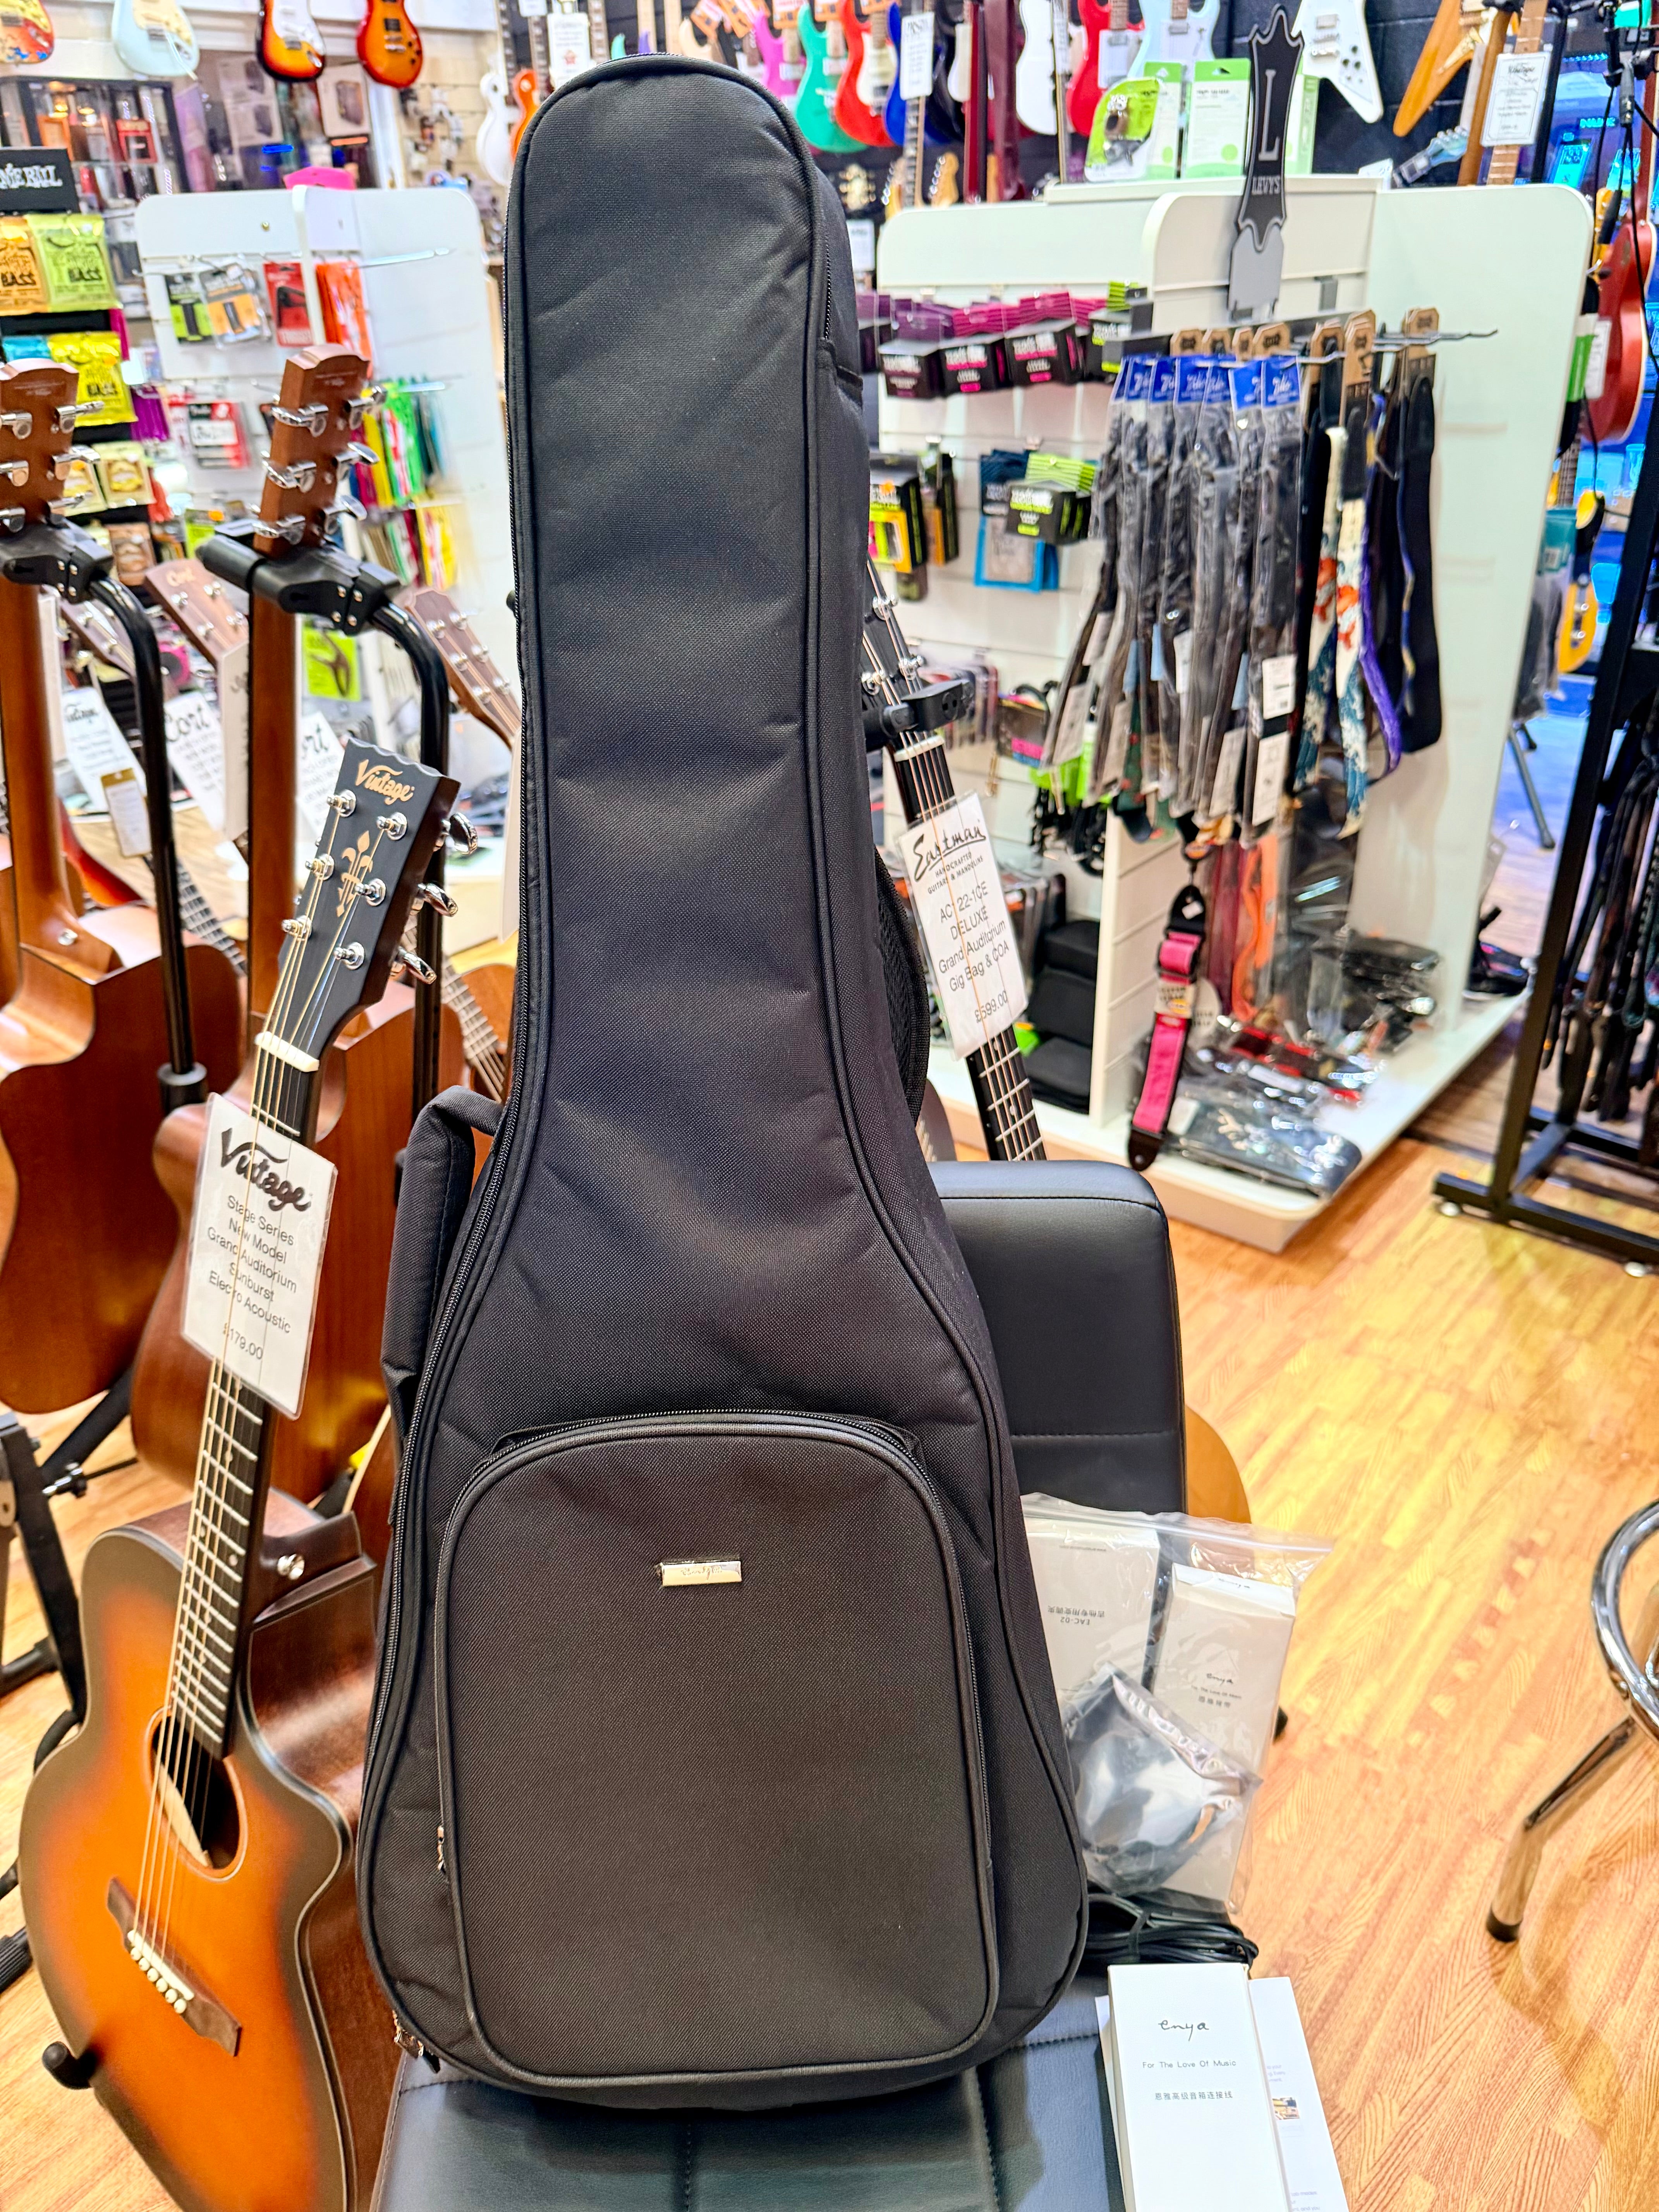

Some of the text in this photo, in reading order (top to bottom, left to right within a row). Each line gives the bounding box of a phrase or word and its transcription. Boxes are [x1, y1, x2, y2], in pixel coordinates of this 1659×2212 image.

[355, 759, 415, 805] Vintage
[913, 826, 986, 882] Eastman
[935, 852, 972, 878] HANDCRAFTED
[950, 905, 988, 940] DELUXE
[939, 920, 1006, 974] Grand Auditorium
[950, 940, 1010, 991] Gig Bag & COA
[974, 990, 1008, 1023] £599.00
[221, 1127, 311, 1212] Vintage
[227, 1195, 294, 1246] Stage Series
[252, 1234, 287, 1264] Model
[229, 1262, 274, 1302] Sunburst
[241, 1249, 297, 1293] Auditorium
[244, 1297, 291, 1333] Acoustic
[1060, 1616, 1091, 1625] EAC-02
[1158, 2020, 1209, 2042] enya
